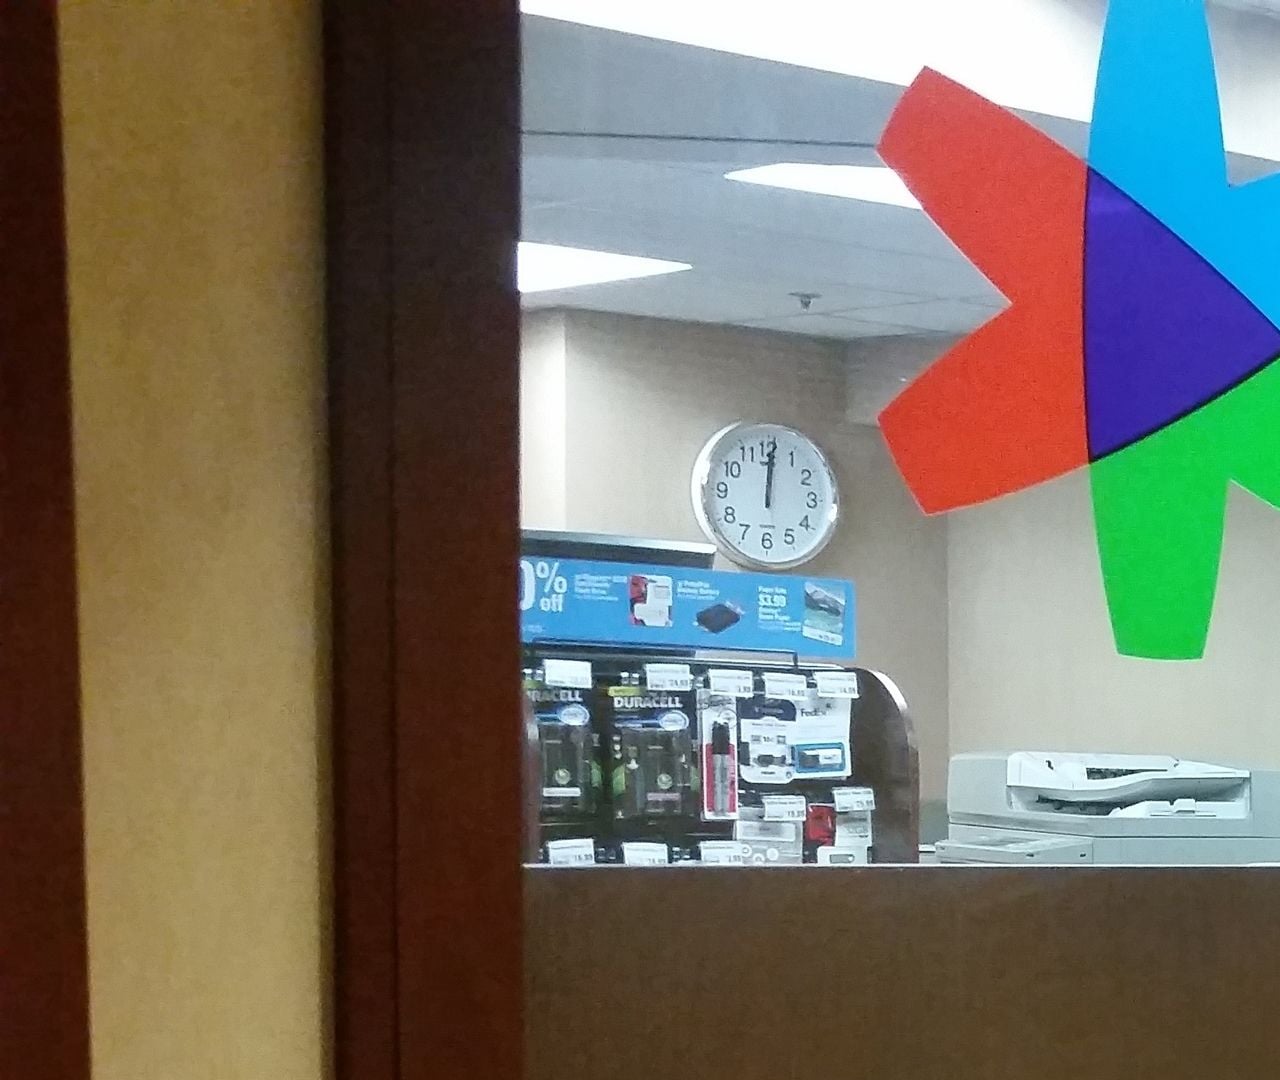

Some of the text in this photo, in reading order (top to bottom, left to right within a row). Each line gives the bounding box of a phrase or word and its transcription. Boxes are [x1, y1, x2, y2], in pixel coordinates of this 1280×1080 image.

[739, 445, 755, 463] 11
[759, 440, 778, 458] 12
[788, 450, 795, 468] 1
[724, 460, 742, 479] 10
[800, 468, 812, 487] 2
[716, 481, 729, 499] 9
[806, 491, 818, 510] 3
[723, 505, 737, 524] 8
[799, 514, 811, 532] 4
[738, 523, 751, 541] 7
[760, 532, 774, 550] 6
[783, 528, 796, 546] 5
[613, 696, 683, 709] DURACELL
